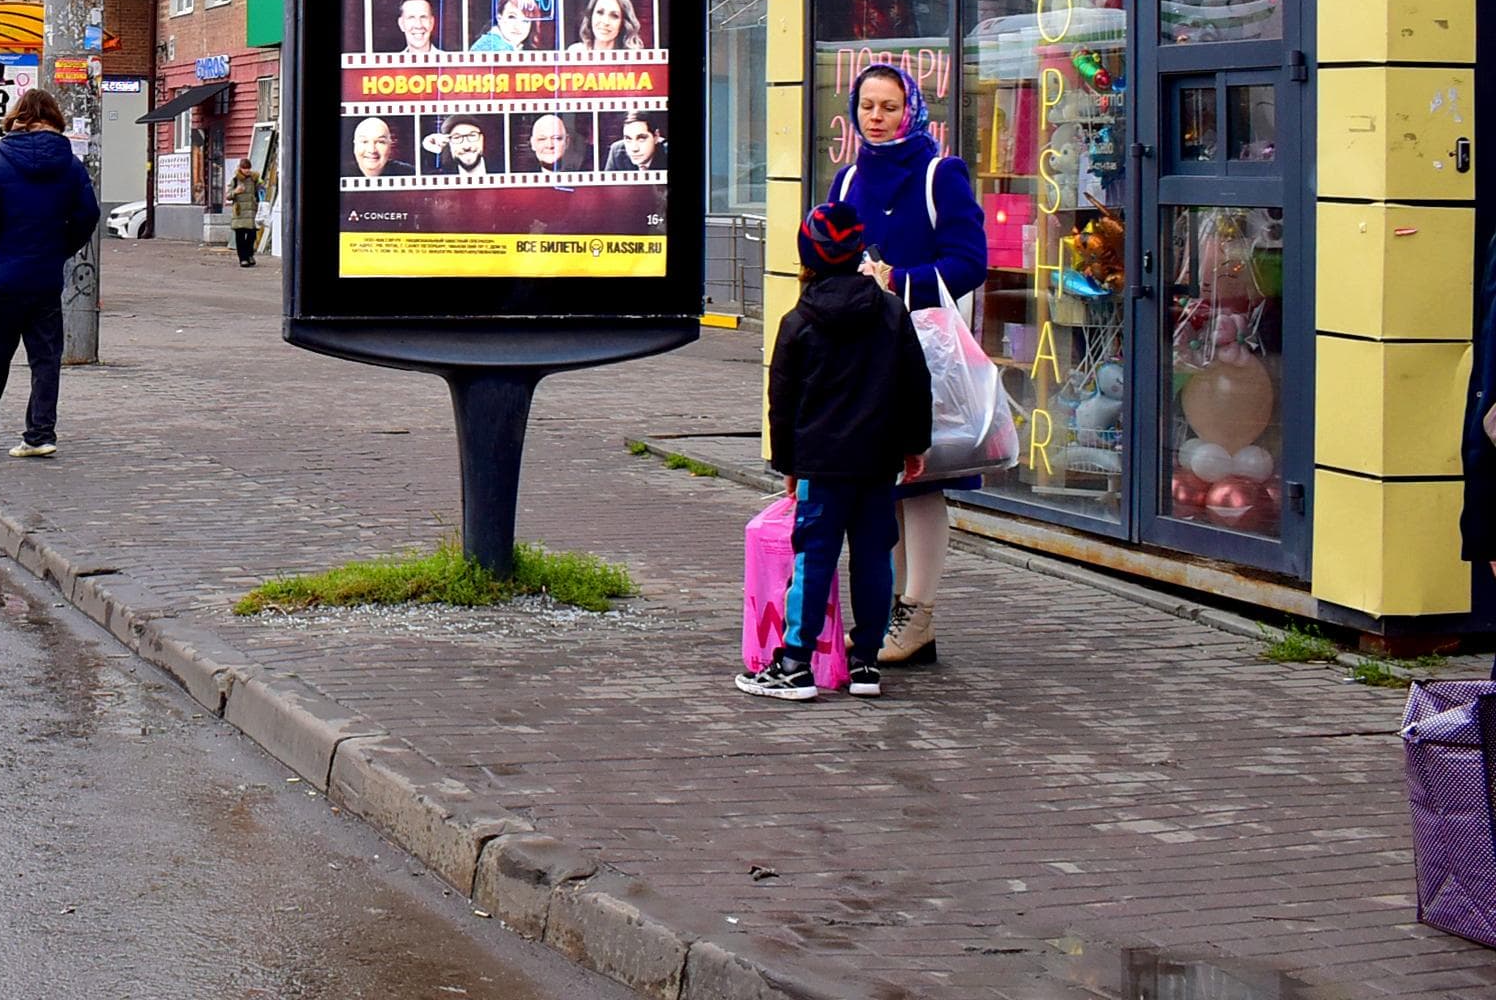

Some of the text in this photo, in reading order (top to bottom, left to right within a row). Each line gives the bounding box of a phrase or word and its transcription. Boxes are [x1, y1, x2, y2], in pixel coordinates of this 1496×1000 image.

[361, 71, 654, 97] НОВОГОДНЯЯ ПРОГРАММА
[646, 213, 665, 226] 16+
[515, 239, 663, 255] ВСЕ БИЛЕТЫ KASSIR.RU
